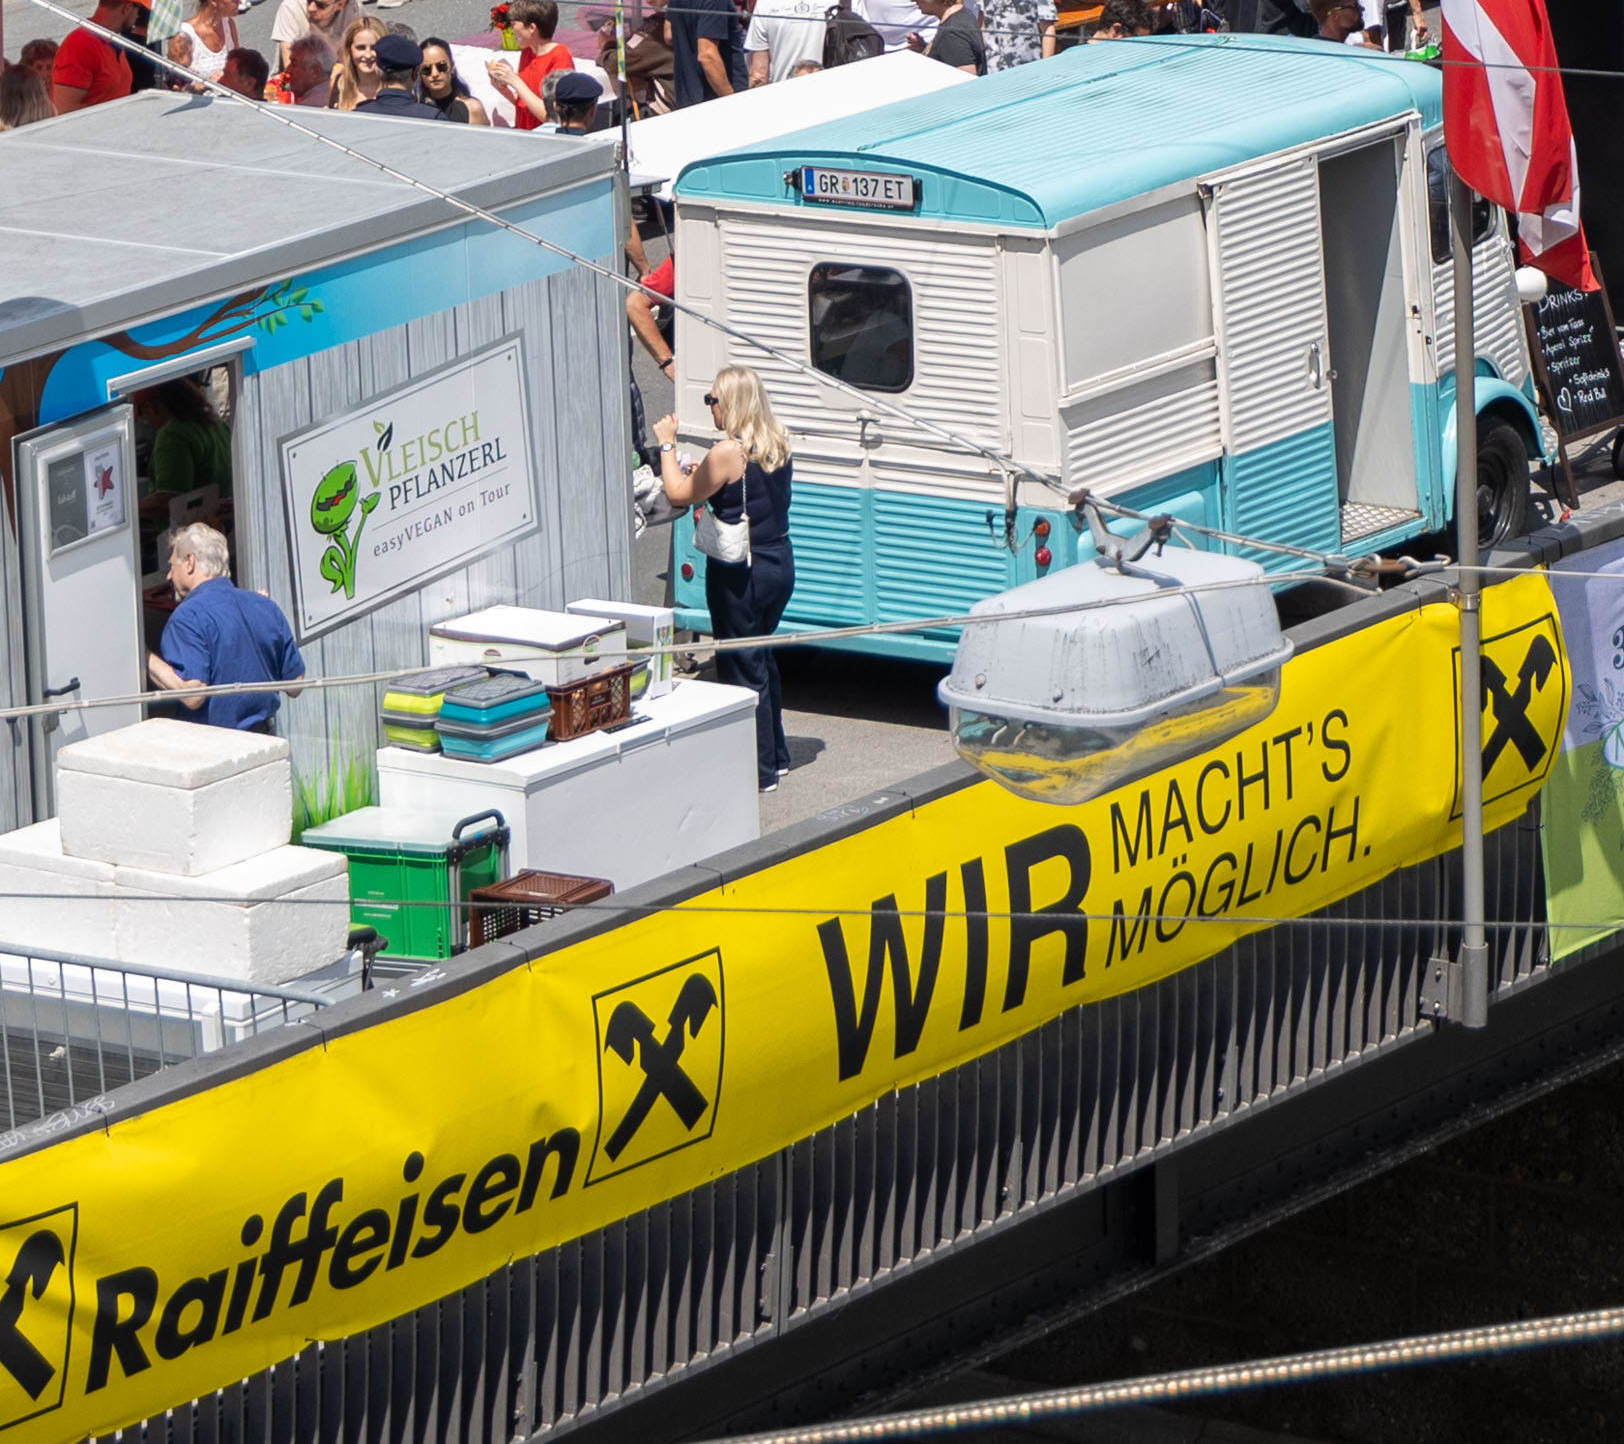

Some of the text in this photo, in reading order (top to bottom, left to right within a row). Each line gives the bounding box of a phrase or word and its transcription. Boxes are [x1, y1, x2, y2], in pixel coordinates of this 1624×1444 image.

[819, 173, 905, 200] GR 137 ET
[359, 410, 481, 489] VLEISCH
[388, 436, 508, 511] PFLANZERL
[372, 482, 512, 557] easyVEGAN on Tour
[816, 708, 1353, 1082] WIR MACHT'S
[1106, 796, 1372, 970] MÖGLICH.
[85, 1123, 583, 1393] Raiffeisen
